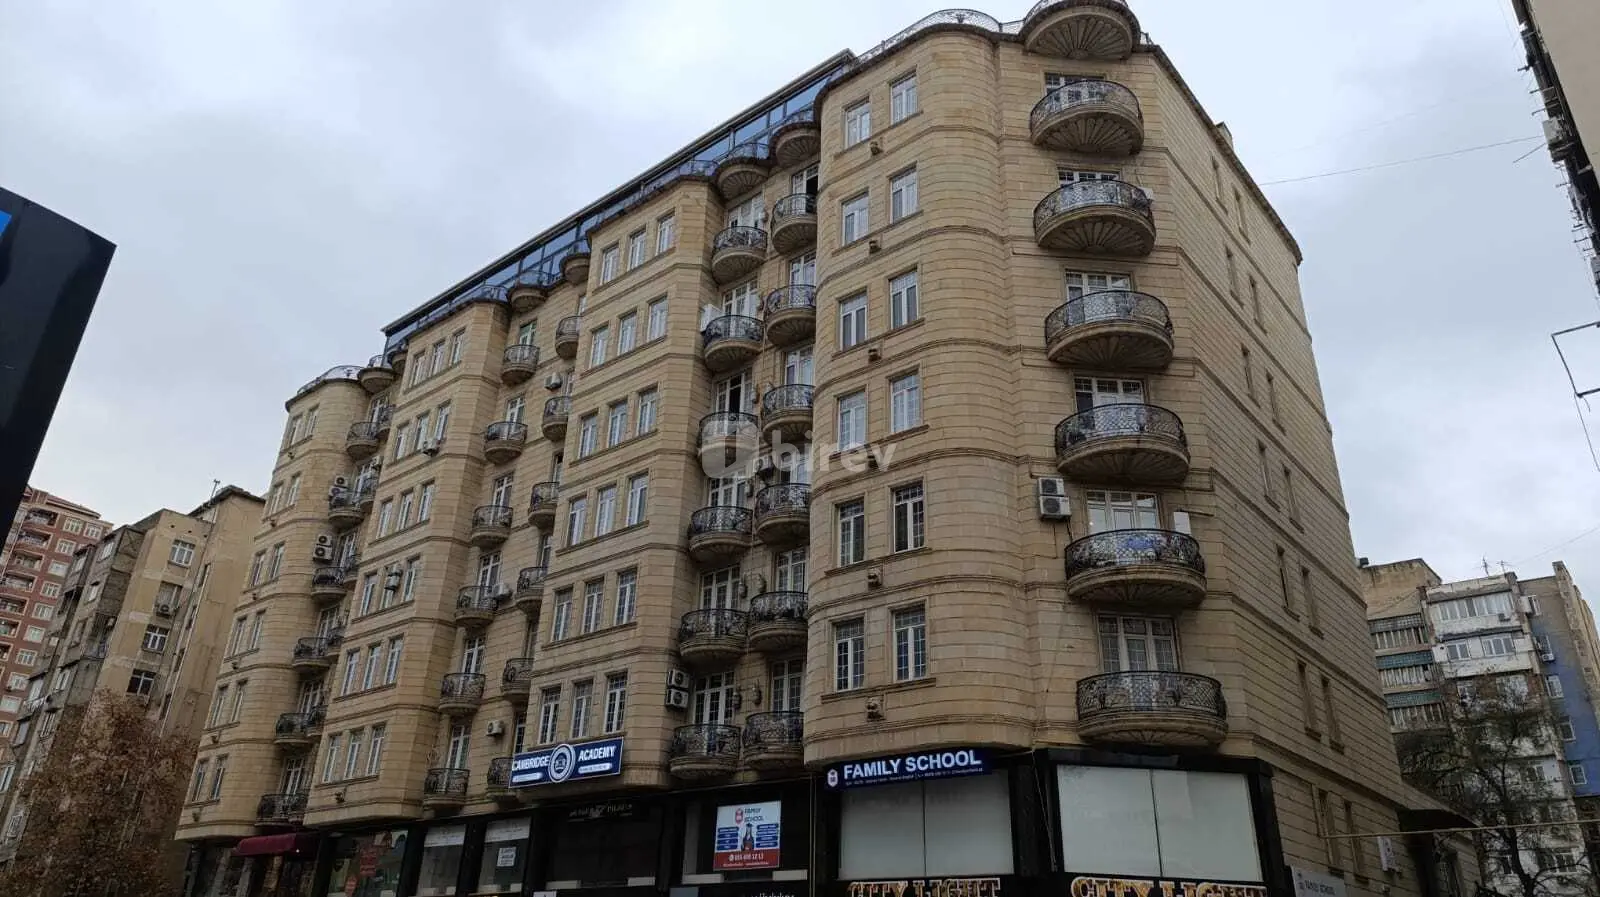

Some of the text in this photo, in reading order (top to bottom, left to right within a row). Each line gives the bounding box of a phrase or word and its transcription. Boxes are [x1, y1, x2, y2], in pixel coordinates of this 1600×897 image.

[511, 745, 616, 771] CAMBRIDGE ACADEMY
[843, 758, 902, 780] FAMILY
[905, 749, 982, 772] SCHOOL
